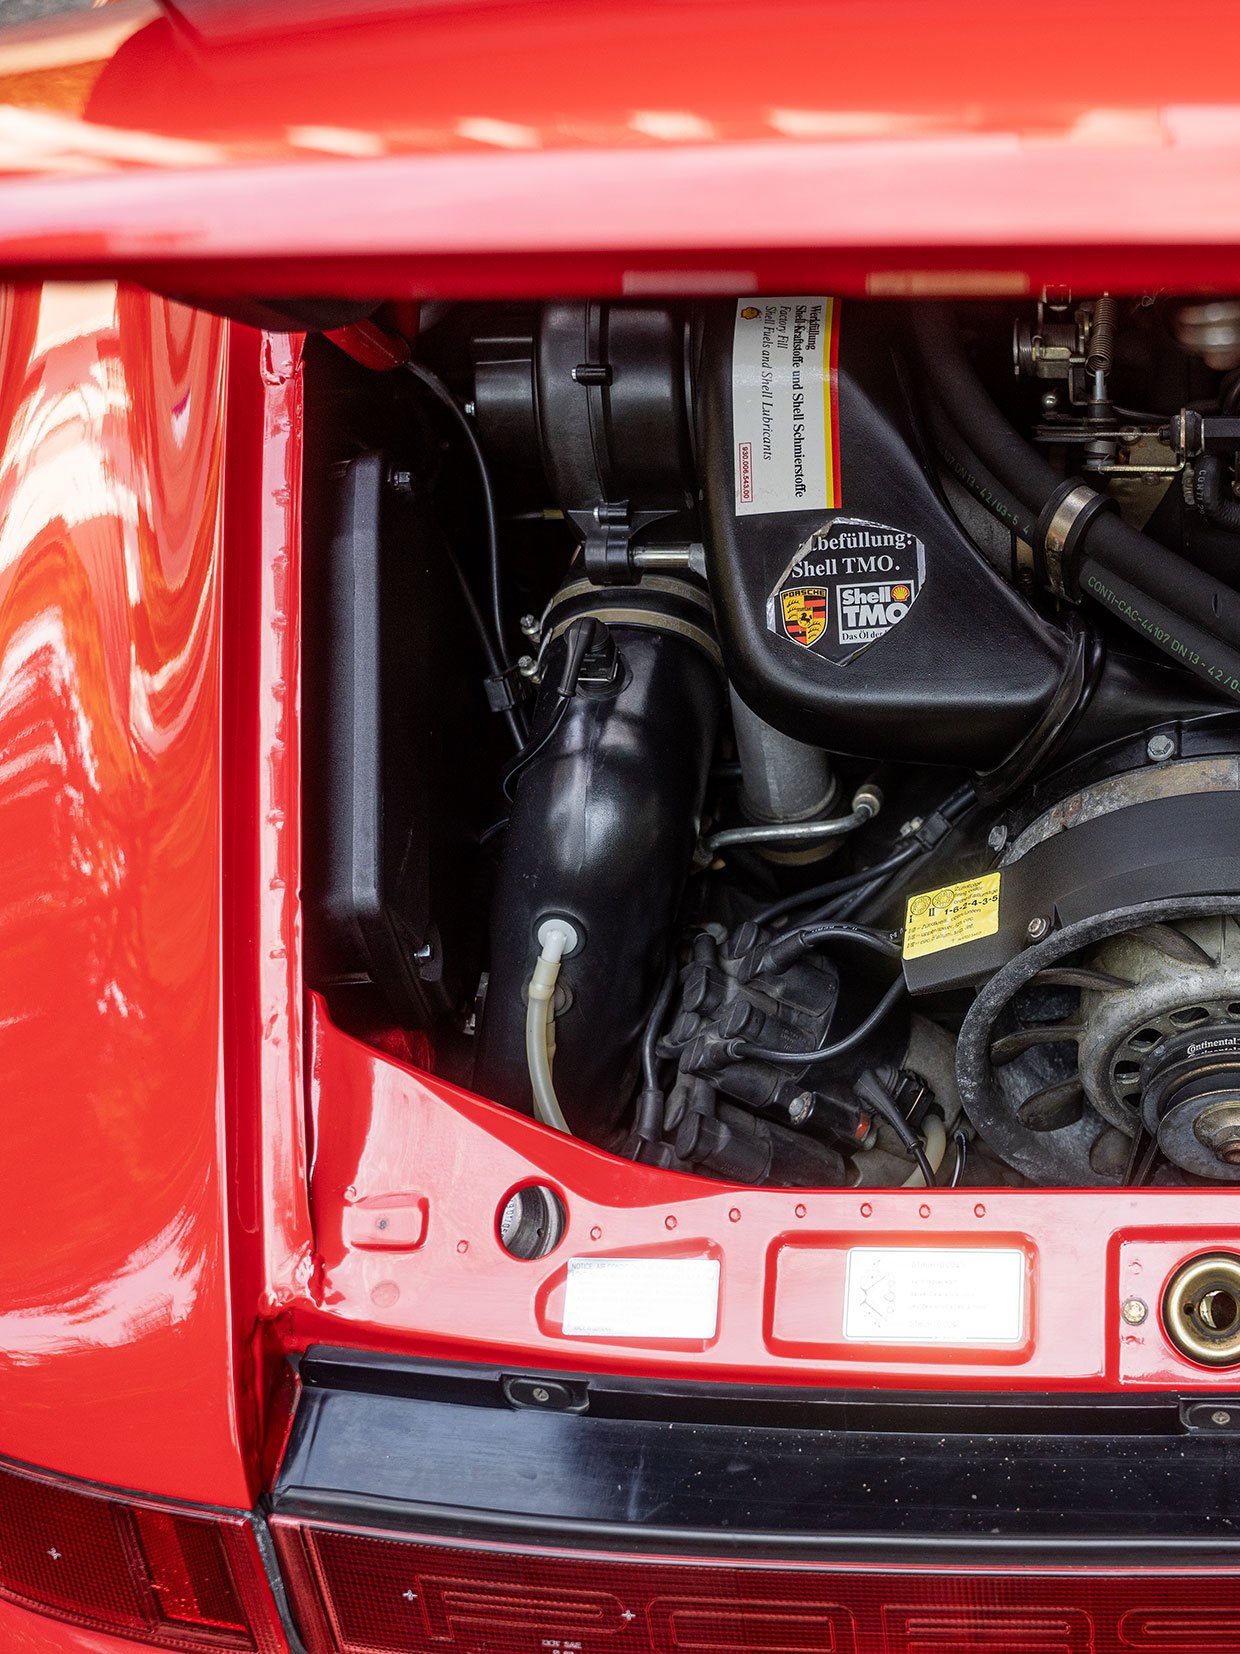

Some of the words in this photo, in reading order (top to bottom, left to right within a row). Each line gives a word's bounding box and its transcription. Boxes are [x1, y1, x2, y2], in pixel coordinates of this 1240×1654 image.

[764, 305, 777, 325] Shell
[776, 305, 791, 333] Factory
[762, 326, 775, 348] Fuels
[777, 336, 789, 349] Fill
[762, 349, 772, 369] and
[761, 371, 773, 398] Shell
[792, 370, 804, 390] und
[792, 393, 804, 420] Shell
[762, 402, 773, 461] Lubricants
[793, 424, 807, 498] Schmierstoffe
[742, 446, 750, 499] 930.006.543.00
[791, 558, 838, 578] Shell
[842, 555, 900, 574] TMO.
[783, 589, 826, 599] PORSCHE
[842, 586, 891, 605] Shell
[842, 602, 909, 627] TMO
[1088, 576, 1171, 643] CONTI-CAC-44107
[1171, 639, 1188, 658] DN
[1189, 651, 1200, 666] 13
[842, 632, 857, 641] Das
[858, 630, 869, 639] Öl
[944, 895, 998, 915] 1-6-2-4-3-5
[1186, 1037, 1236, 1055] Continental
